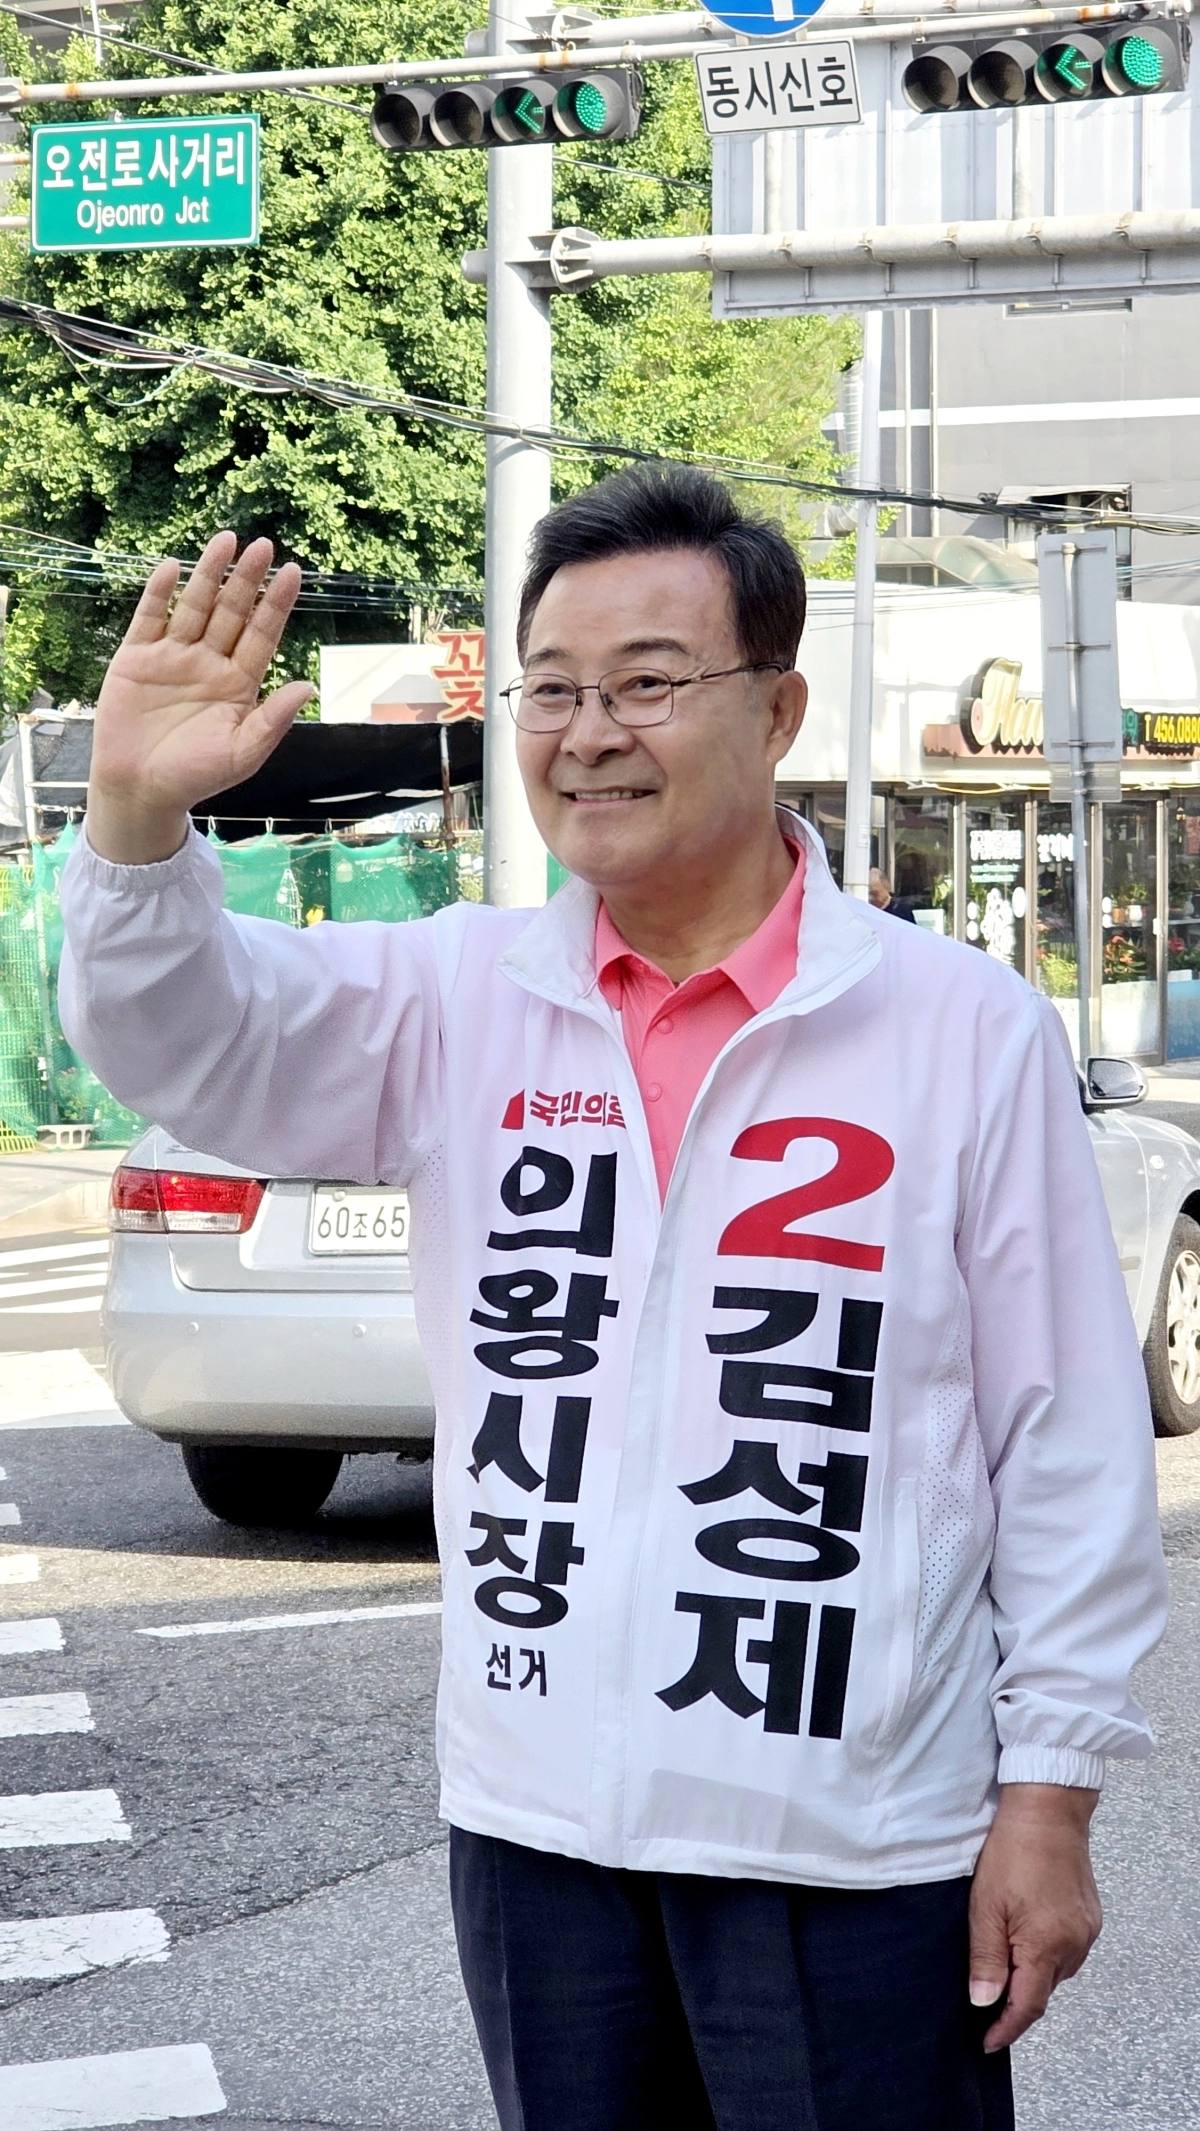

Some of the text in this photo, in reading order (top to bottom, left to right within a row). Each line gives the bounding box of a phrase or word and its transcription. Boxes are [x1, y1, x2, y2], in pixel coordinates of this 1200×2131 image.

[706, 56, 853, 118] 동시신호
[42, 131, 245, 192] 오전로사거리
[76, 195, 209, 235] Ojeonro Jct
[433, 633, 485, 720] 꽃
[718, 1117, 895, 1272] 2
[464, 1145, 620, 1629] 의왕시장
[654, 1285, 884, 1740] 김성제
[486, 1643, 548, 1697] 선거
